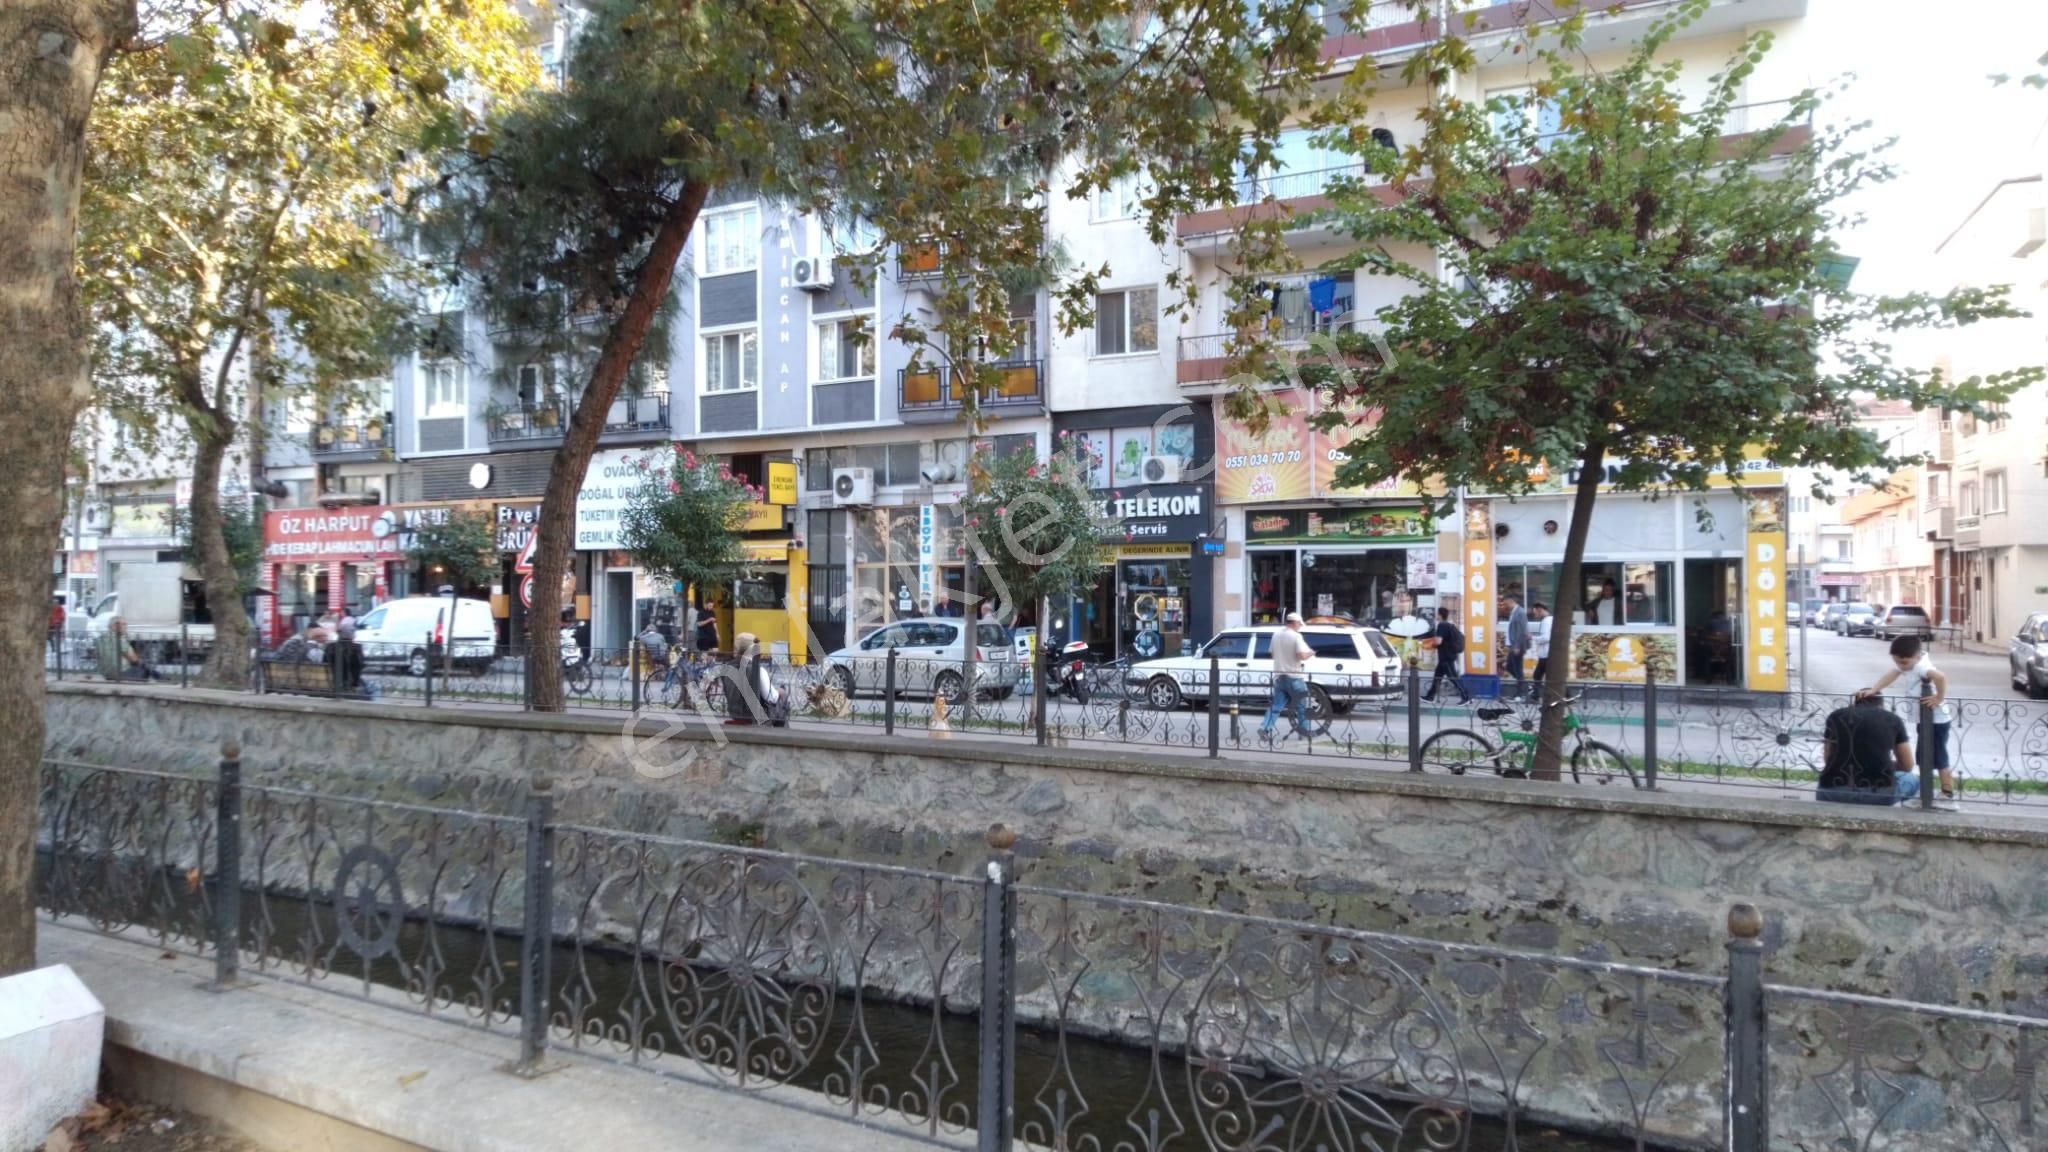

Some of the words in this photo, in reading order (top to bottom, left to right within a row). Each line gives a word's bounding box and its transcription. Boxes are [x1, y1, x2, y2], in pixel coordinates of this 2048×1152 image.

[1225, 455, 1247, 469] 0551
[1250, 453, 1268, 467] 034
[1272, 451, 1285, 464] 70
[1287, 449, 1301, 463] 70
[515, 511, 532, 523] ve
[1115, 495, 1201, 518] TELEKOM
[280, 514, 302, 535] ÖZ
[304, 514, 370, 532] HARPUT
[1130, 523, 1168, 536] Servis
[1470, 550, 1486, 668] DÖNER
[1757, 543, 1776, 674] DÖNER
